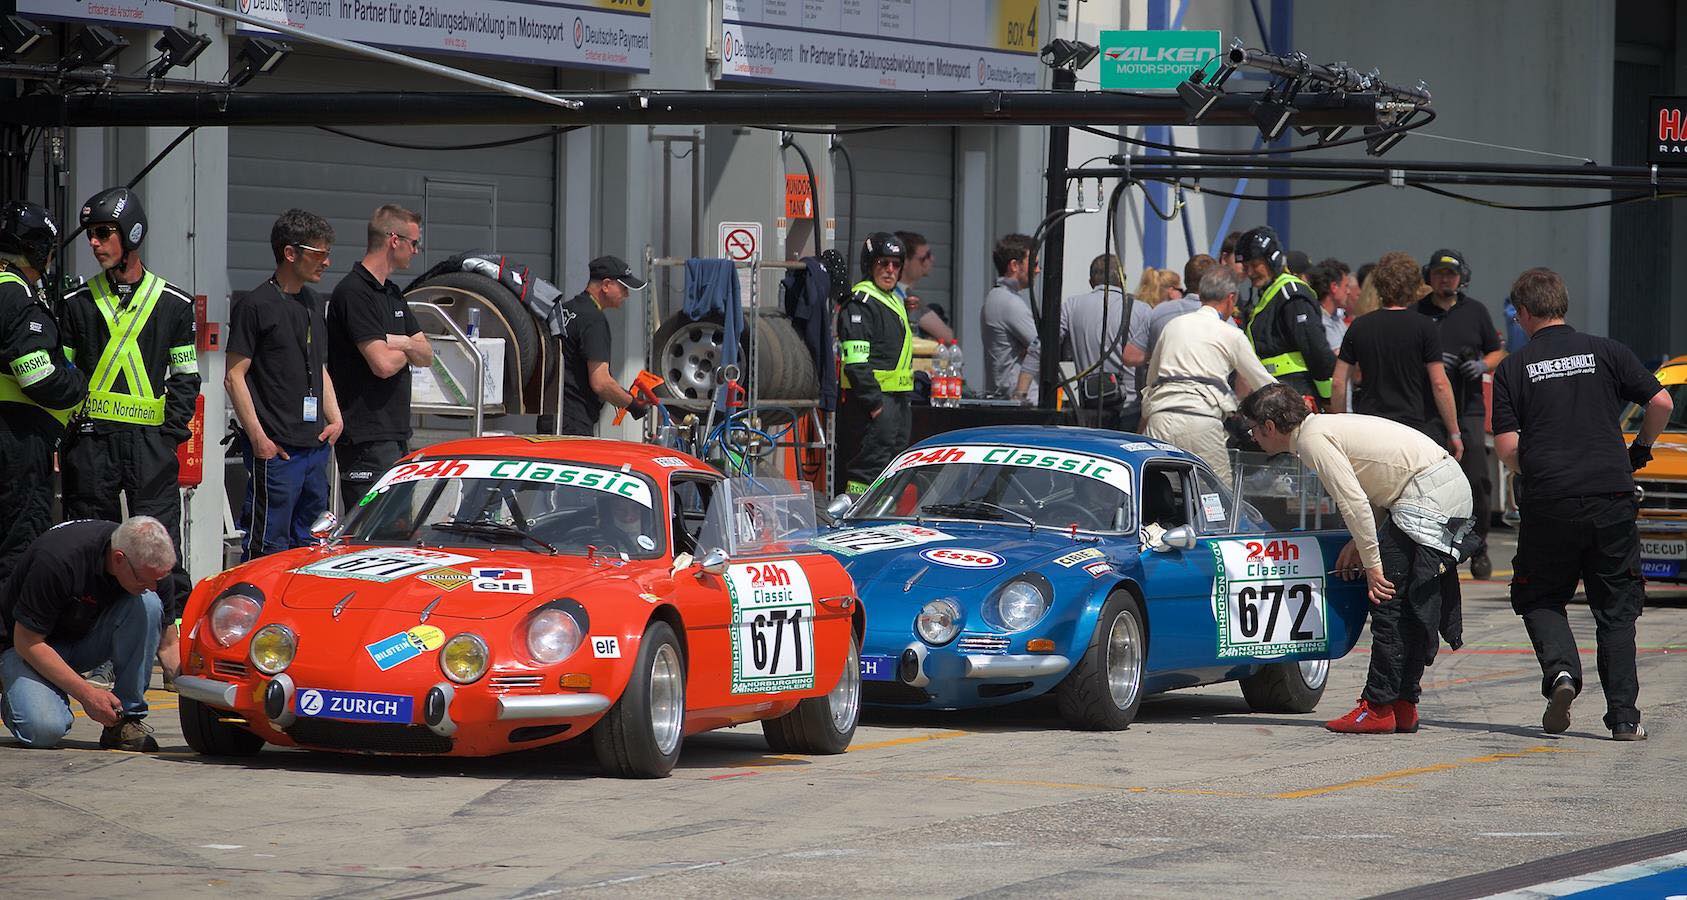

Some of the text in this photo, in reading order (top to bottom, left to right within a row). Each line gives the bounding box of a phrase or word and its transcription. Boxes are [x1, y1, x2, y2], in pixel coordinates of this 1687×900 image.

[294, 0, 331, 20] Payment
[340, 0, 564, 44] Ihr Partner für die Zahlungsabwicklung im Motorsport
[1008, 6, 1038, 47] BOX 4
[585, 25, 649, 53] Deutsche Payment
[735, 39, 793, 64] Deutsche Payment
[799, 43, 971, 82] Ihr Partner für die Zahlungsabwicklung im Motorsport
[1104, 47, 1217, 62] FALKEN
[1116, 63, 1201, 74] MOTORSPORTS
[112, 197, 127, 219] uvex
[1526, 361, 1553, 378] ALPINE
[1561, 354, 1595, 371] RENAULT
[112, 400, 156, 420] Nordrhein
[898, 447, 1113, 479] 24h Classic
[388, 459, 640, 497] 24h Classic
[1246, 540, 1299, 562] 24h
[1661, 543, 1684, 555] CUP
[746, 564, 791, 587] 24h
[1247, 562, 1299, 577] Classic
[754, 588, 793, 604] Classic
[1210, 542, 1226, 648] ADAC NORDRHEIN
[1238, 584, 1313, 643] 672
[374, 640, 410, 662] BILSTEIN
[596, 640, 616, 654] elf
[750, 609, 803, 675] 671
[1218, 646, 1239, 658] 24h
[1238, 646, 1326, 657] NORDSCHLEIFE
[731, 682, 747, 694] 24h
[747, 683, 813, 693] NORDSCHLEIFE
[330, 697, 398, 716] ZURICH
